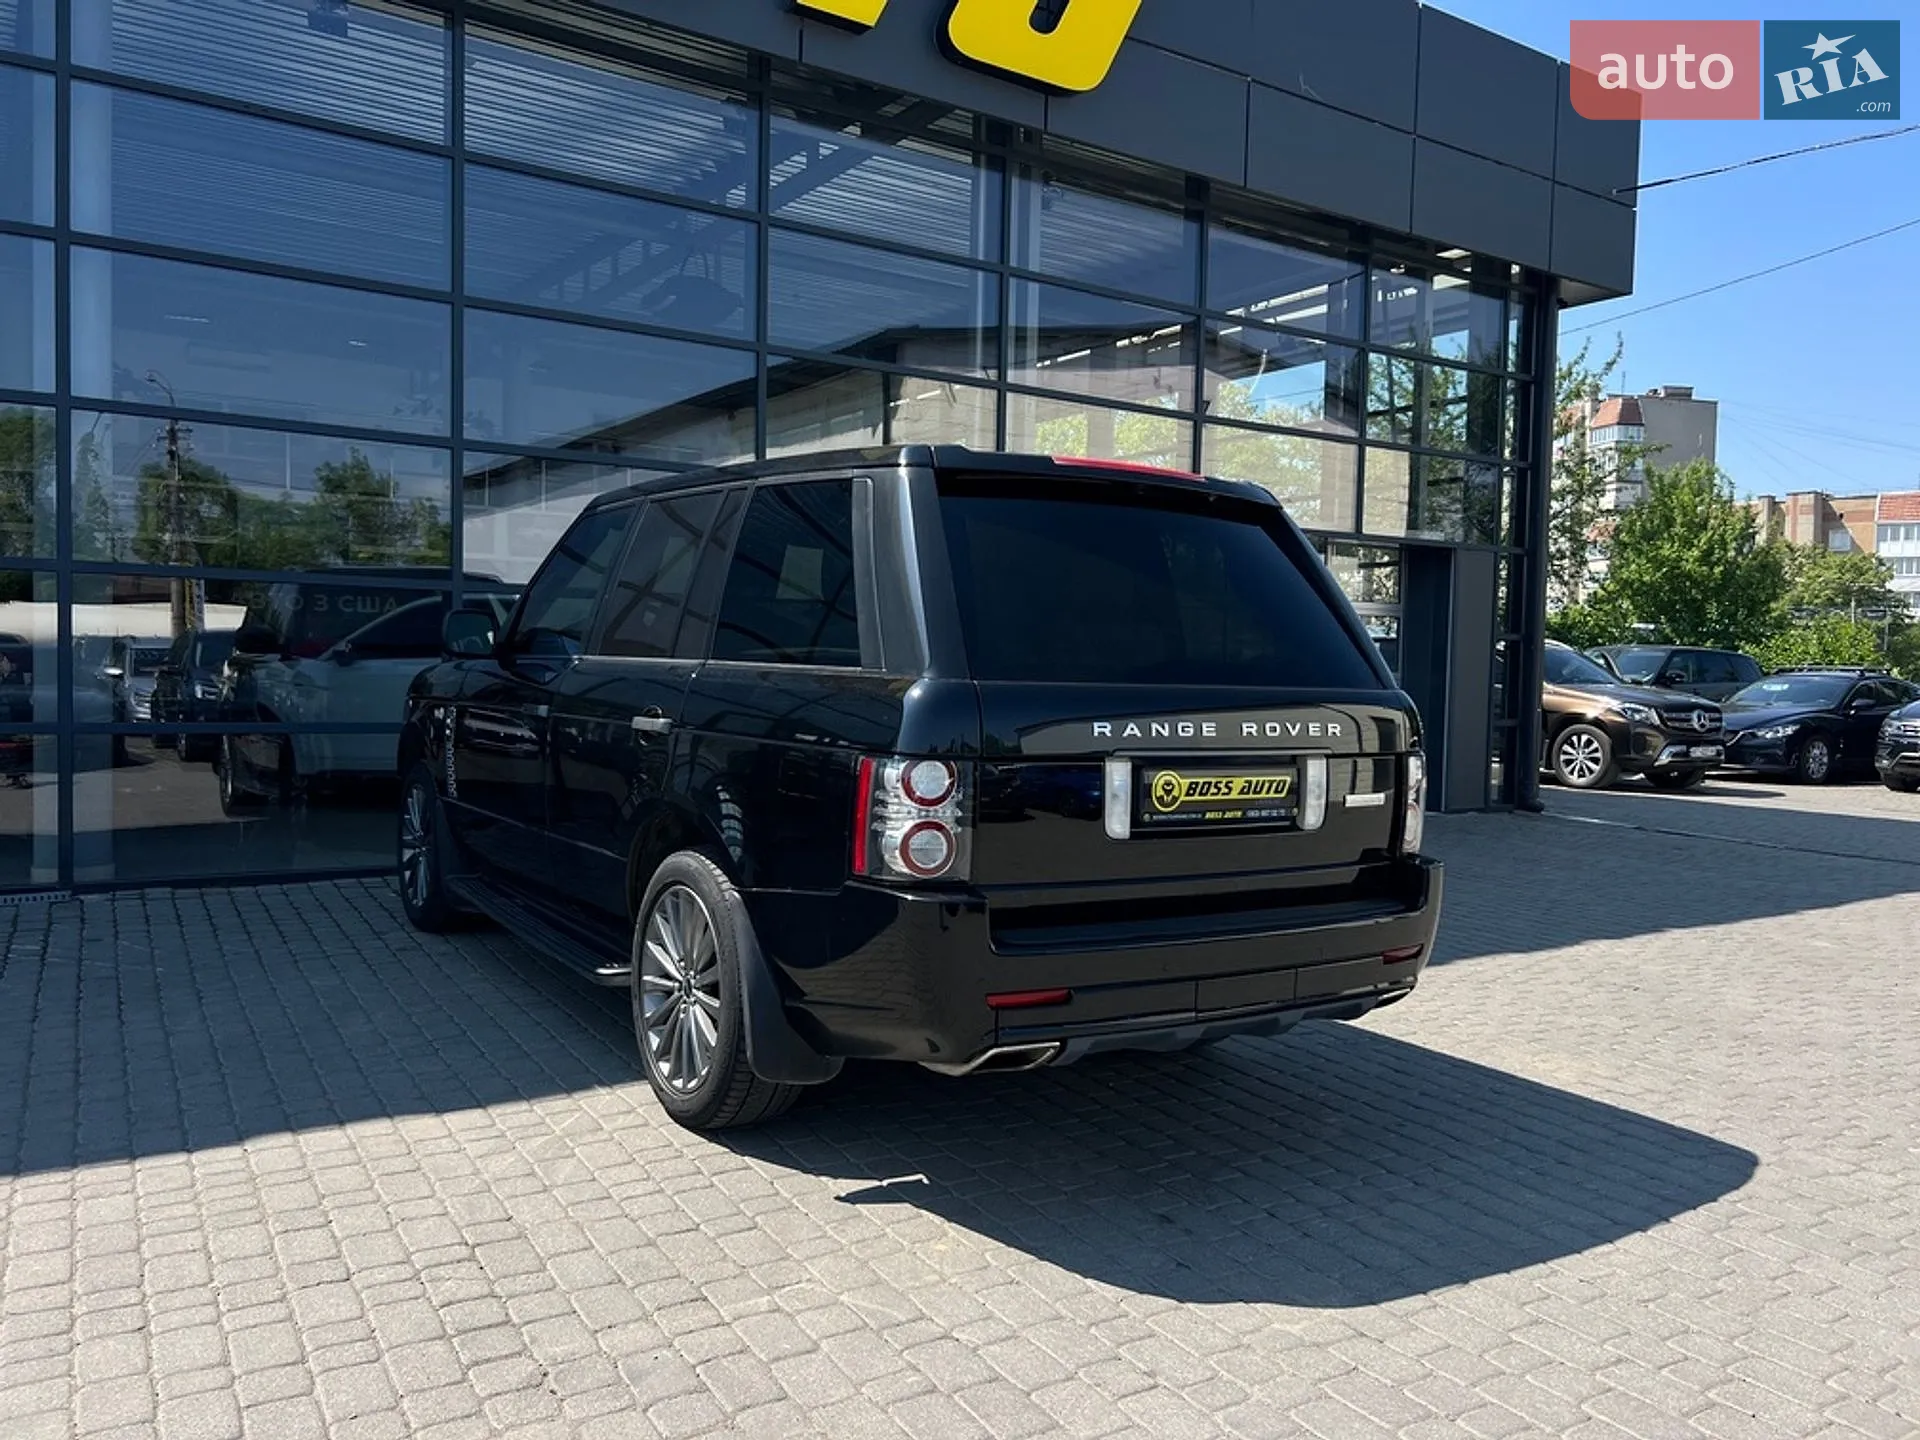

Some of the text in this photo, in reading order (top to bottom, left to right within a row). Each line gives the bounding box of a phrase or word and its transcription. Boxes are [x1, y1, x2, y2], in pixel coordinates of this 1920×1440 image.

[337, 595, 398, 614] США
[1093, 721, 1342, 737] RANGE ROVER
[1184, 779, 1289, 797] BOSS AUTO
